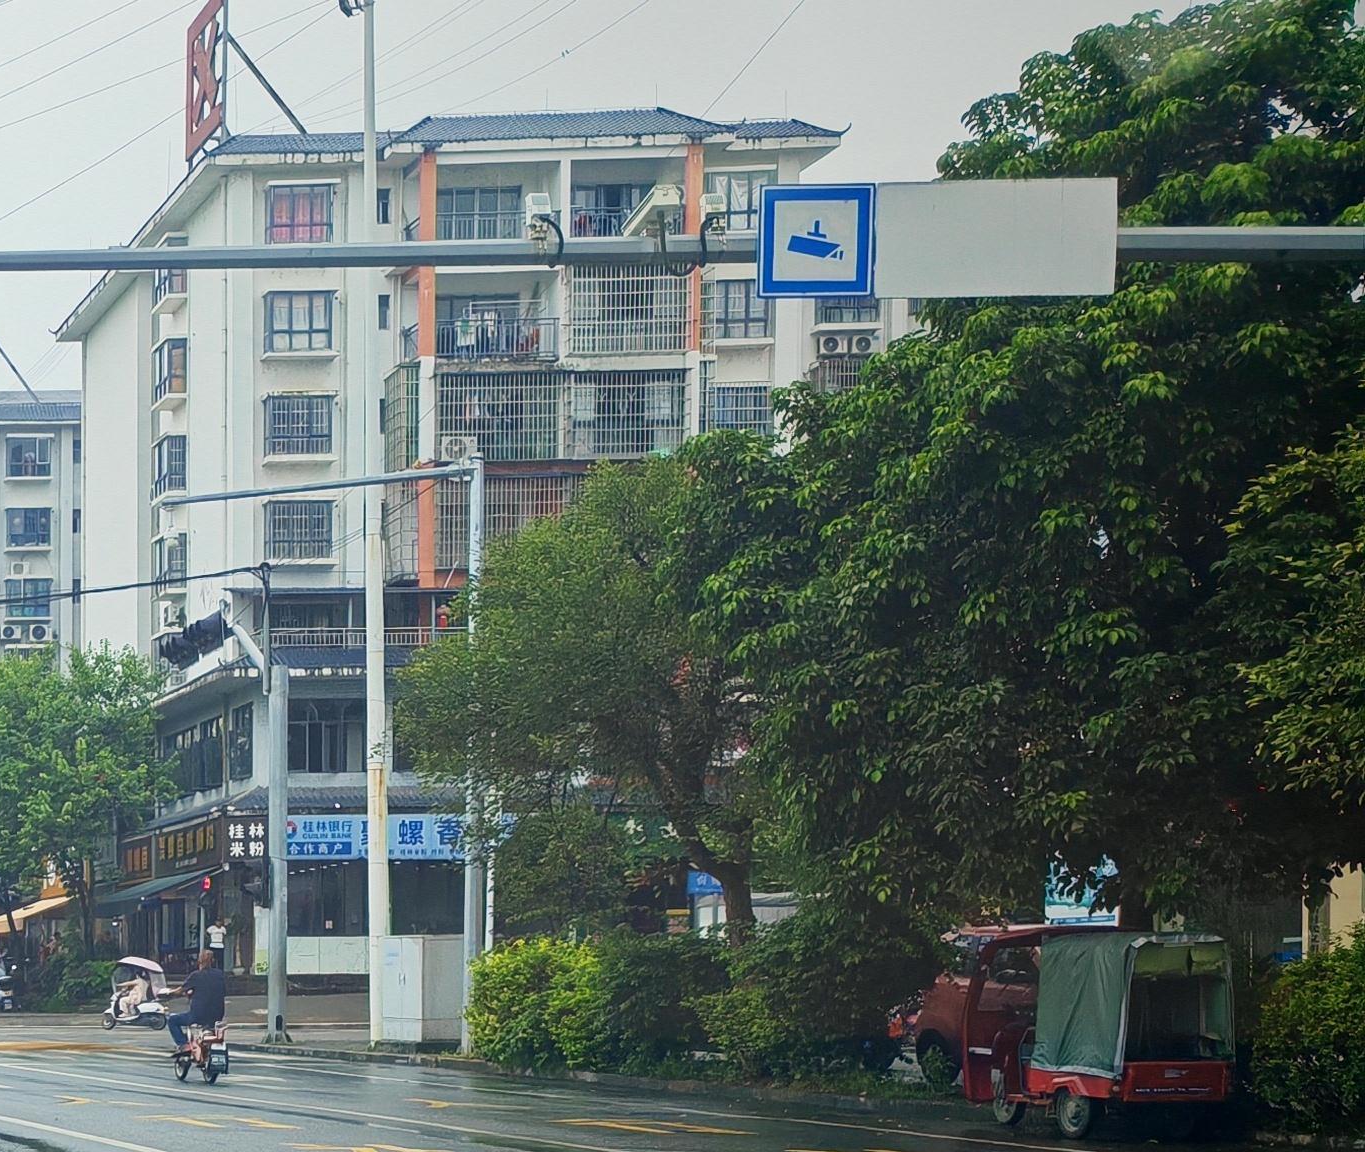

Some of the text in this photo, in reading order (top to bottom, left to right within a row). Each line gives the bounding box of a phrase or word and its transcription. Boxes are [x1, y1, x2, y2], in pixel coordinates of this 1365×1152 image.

[228, 823, 264, 839] 桂林
[302, 820, 352, 832] 桂林银行
[229, 841, 264, 857] 米粉
[289, 843, 343, 855] 合作商户
